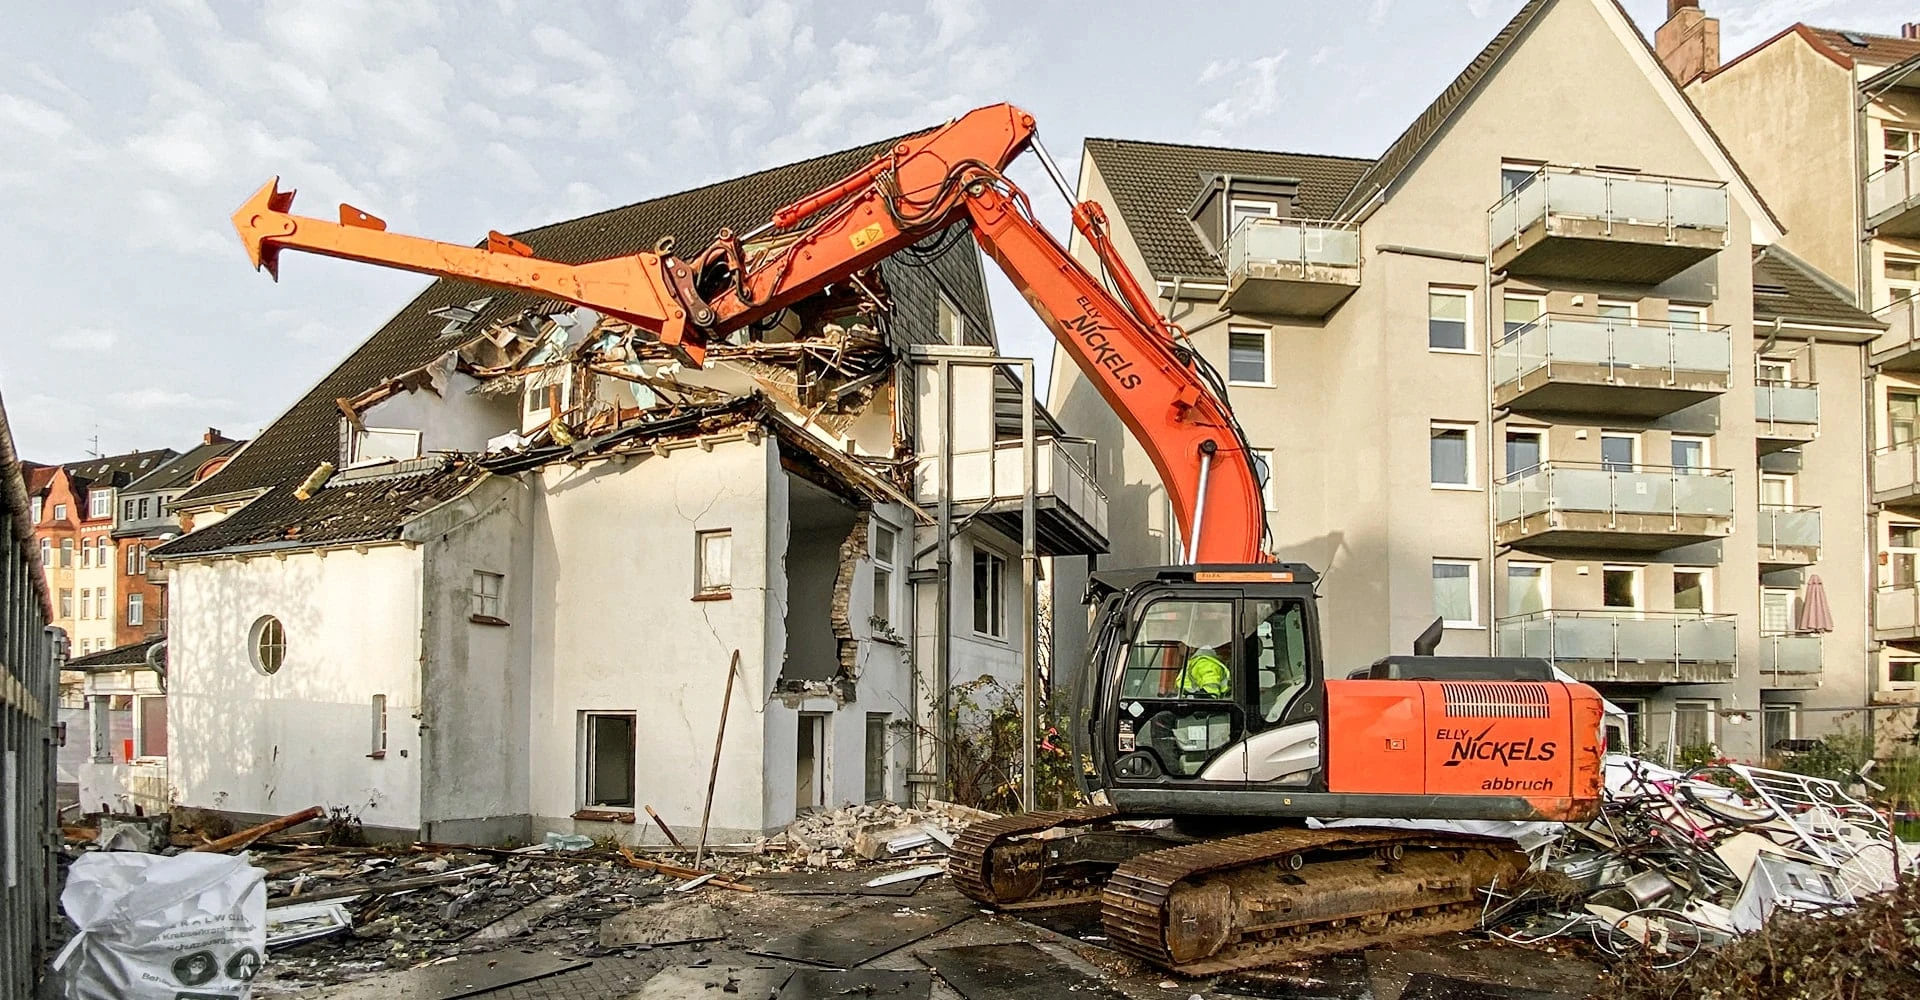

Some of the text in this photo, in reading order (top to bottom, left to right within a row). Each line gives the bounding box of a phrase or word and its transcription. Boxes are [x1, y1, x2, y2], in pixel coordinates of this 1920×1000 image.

[1076, 295, 1102, 319] ELLY
[1069, 314, 1142, 390] NICKELS
[1436, 728, 1470, 740] ELLY
[1449, 735, 1557, 767] NICKELS
[1481, 777, 1553, 791] abbruch
